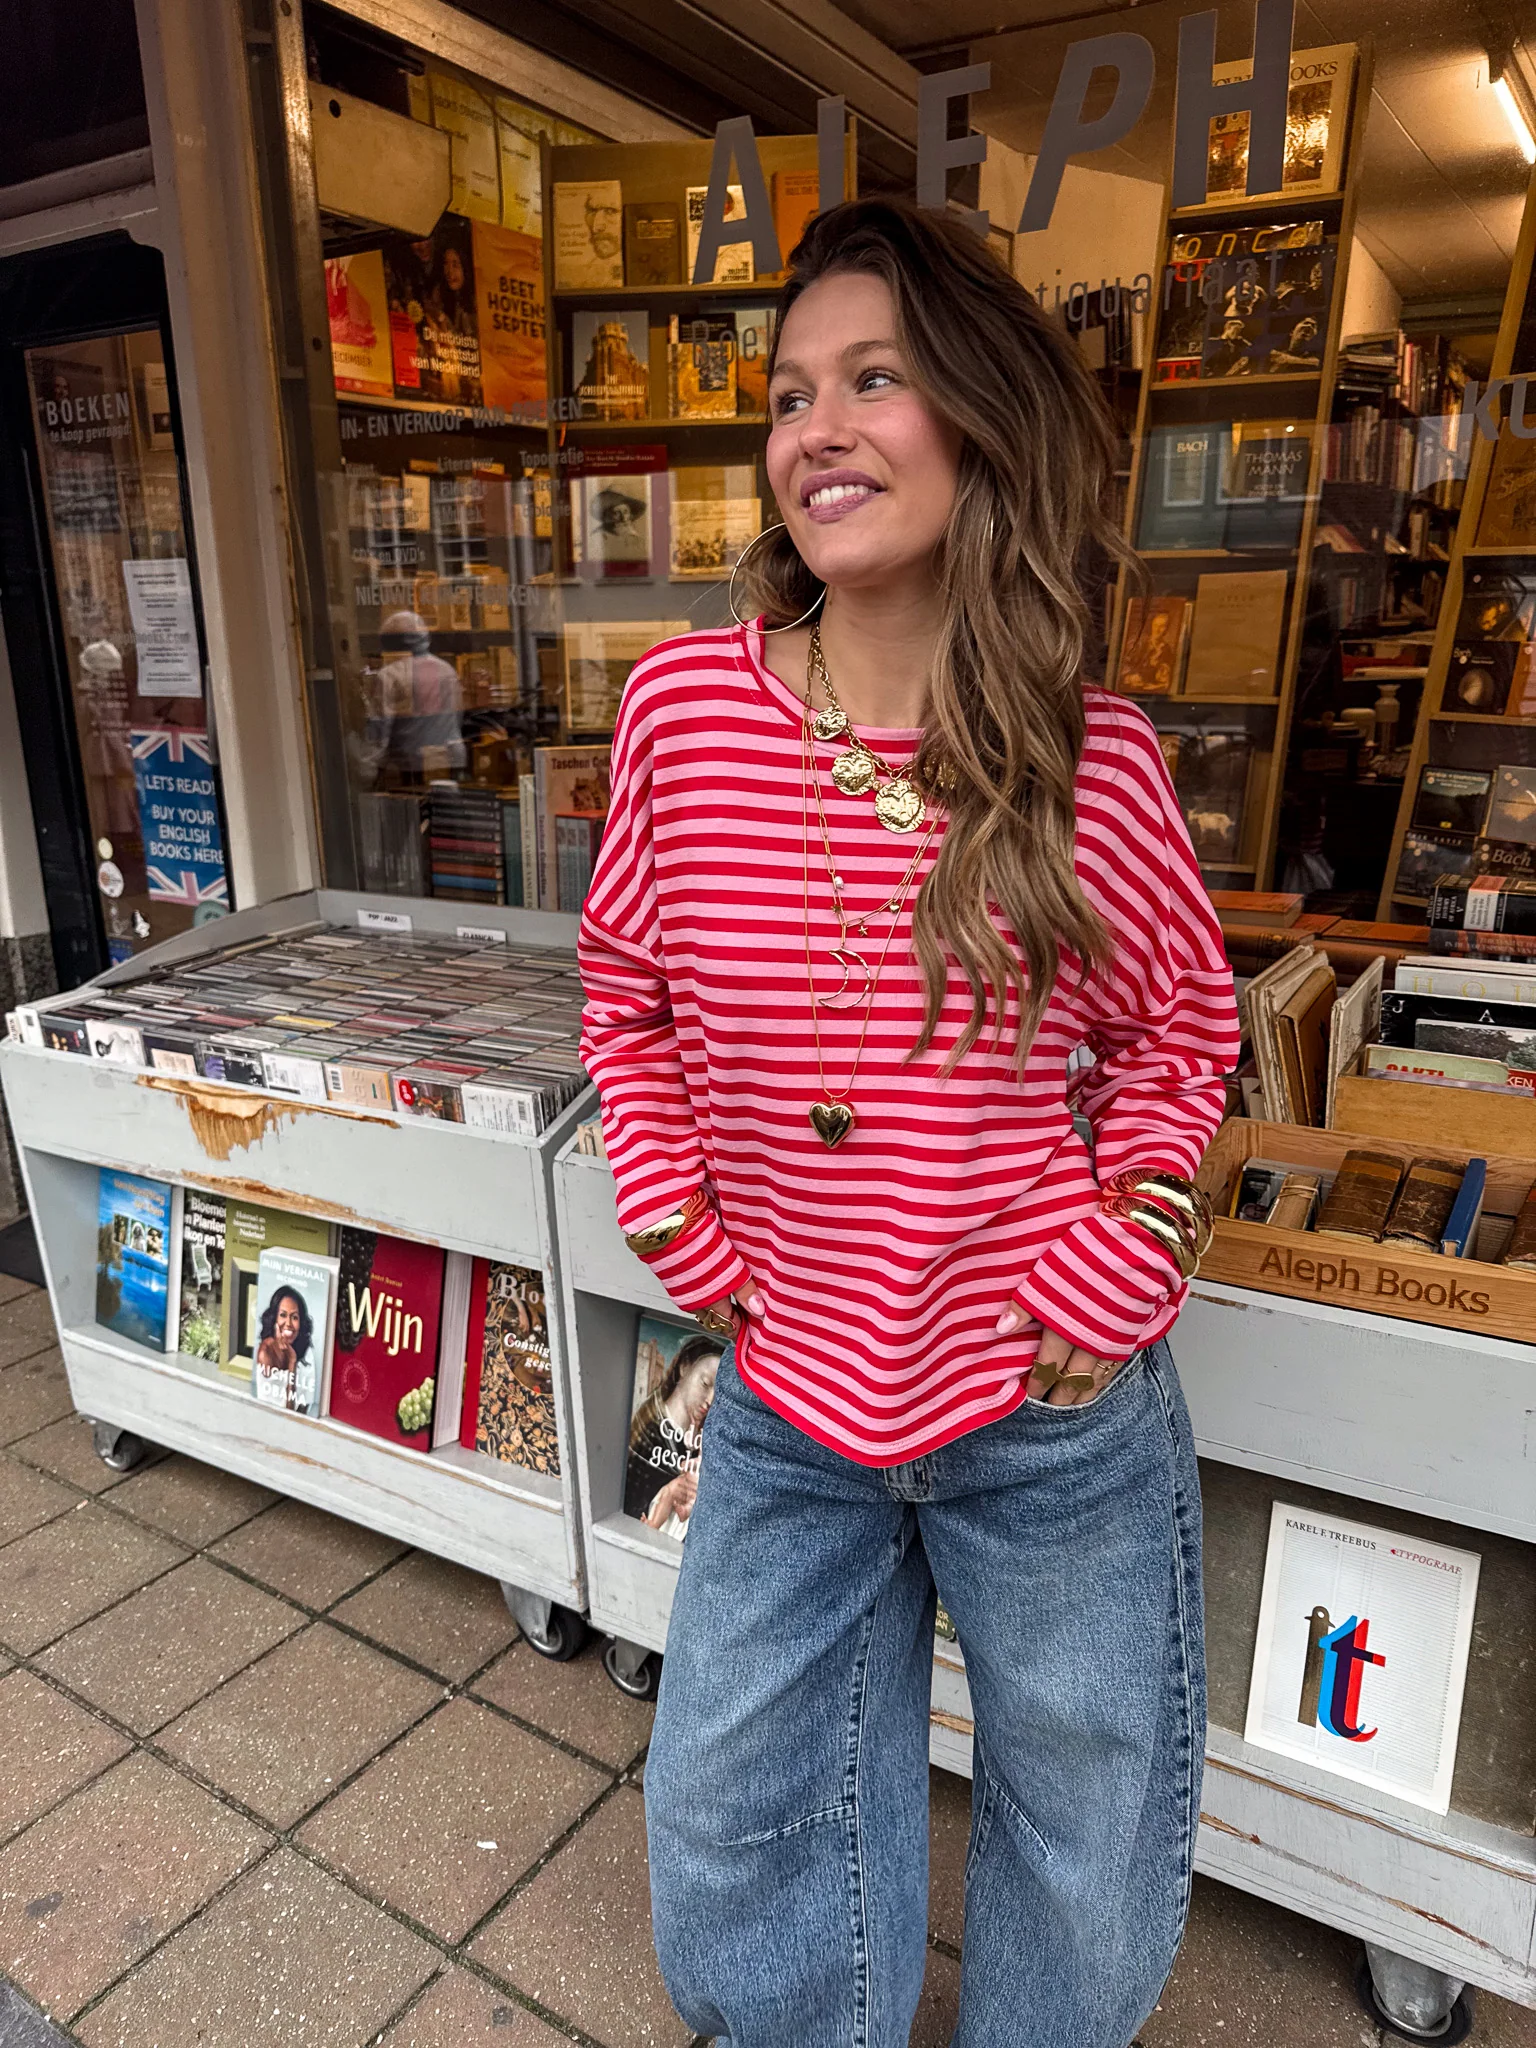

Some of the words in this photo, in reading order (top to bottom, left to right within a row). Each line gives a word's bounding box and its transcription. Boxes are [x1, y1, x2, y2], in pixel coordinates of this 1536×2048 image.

[1290, 61, 1338, 82] OOKS
[498, 275, 536, 295] BEET
[1035, 250, 1283, 331] tiquariaat
[333, 351, 373, 367] ECEMBER
[46, 391, 130, 427] BOEKEN
[368, 414, 390, 438] EN
[392, 409, 464, 436] VERKOOP
[60, 427, 84, 445] koop
[1176, 440, 1209, 453] BACH
[1244, 450, 1303, 465] THOMAS
[1249, 463, 1295, 477] MANN
[552, 758, 590, 770] Taschen
[145, 774, 175, 792] LET'S
[177, 777, 216, 796] READ!
[152, 804, 175, 821] BUY
[178, 808, 216, 826] YOUR
[159, 823, 211, 845] ENGLISH
[150, 841, 192, 861] BOOKS
[1492, 848, 1532, 867] Bach
[192, 1213, 226, 1234] Planten
[204, 1234, 216, 1247] en
[216, 1234, 226, 1250] Te
[262, 1257, 282, 1271] MIJN
[284, 1263, 325, 1283] VERHAAL
[1259, 1247, 1361, 1292] Aleph
[1376, 1266, 1491, 1315] Books
[499, 1273, 546, 1304] Blo
[349, 1282, 423, 1357] Wijn
[256, 1363, 317, 1391] MICHELLE
[263, 1380, 307, 1408] OBAMA
[1285, 1519, 1318, 1536] KAREL
[1329, 1530, 1377, 1551] TREEBUS
